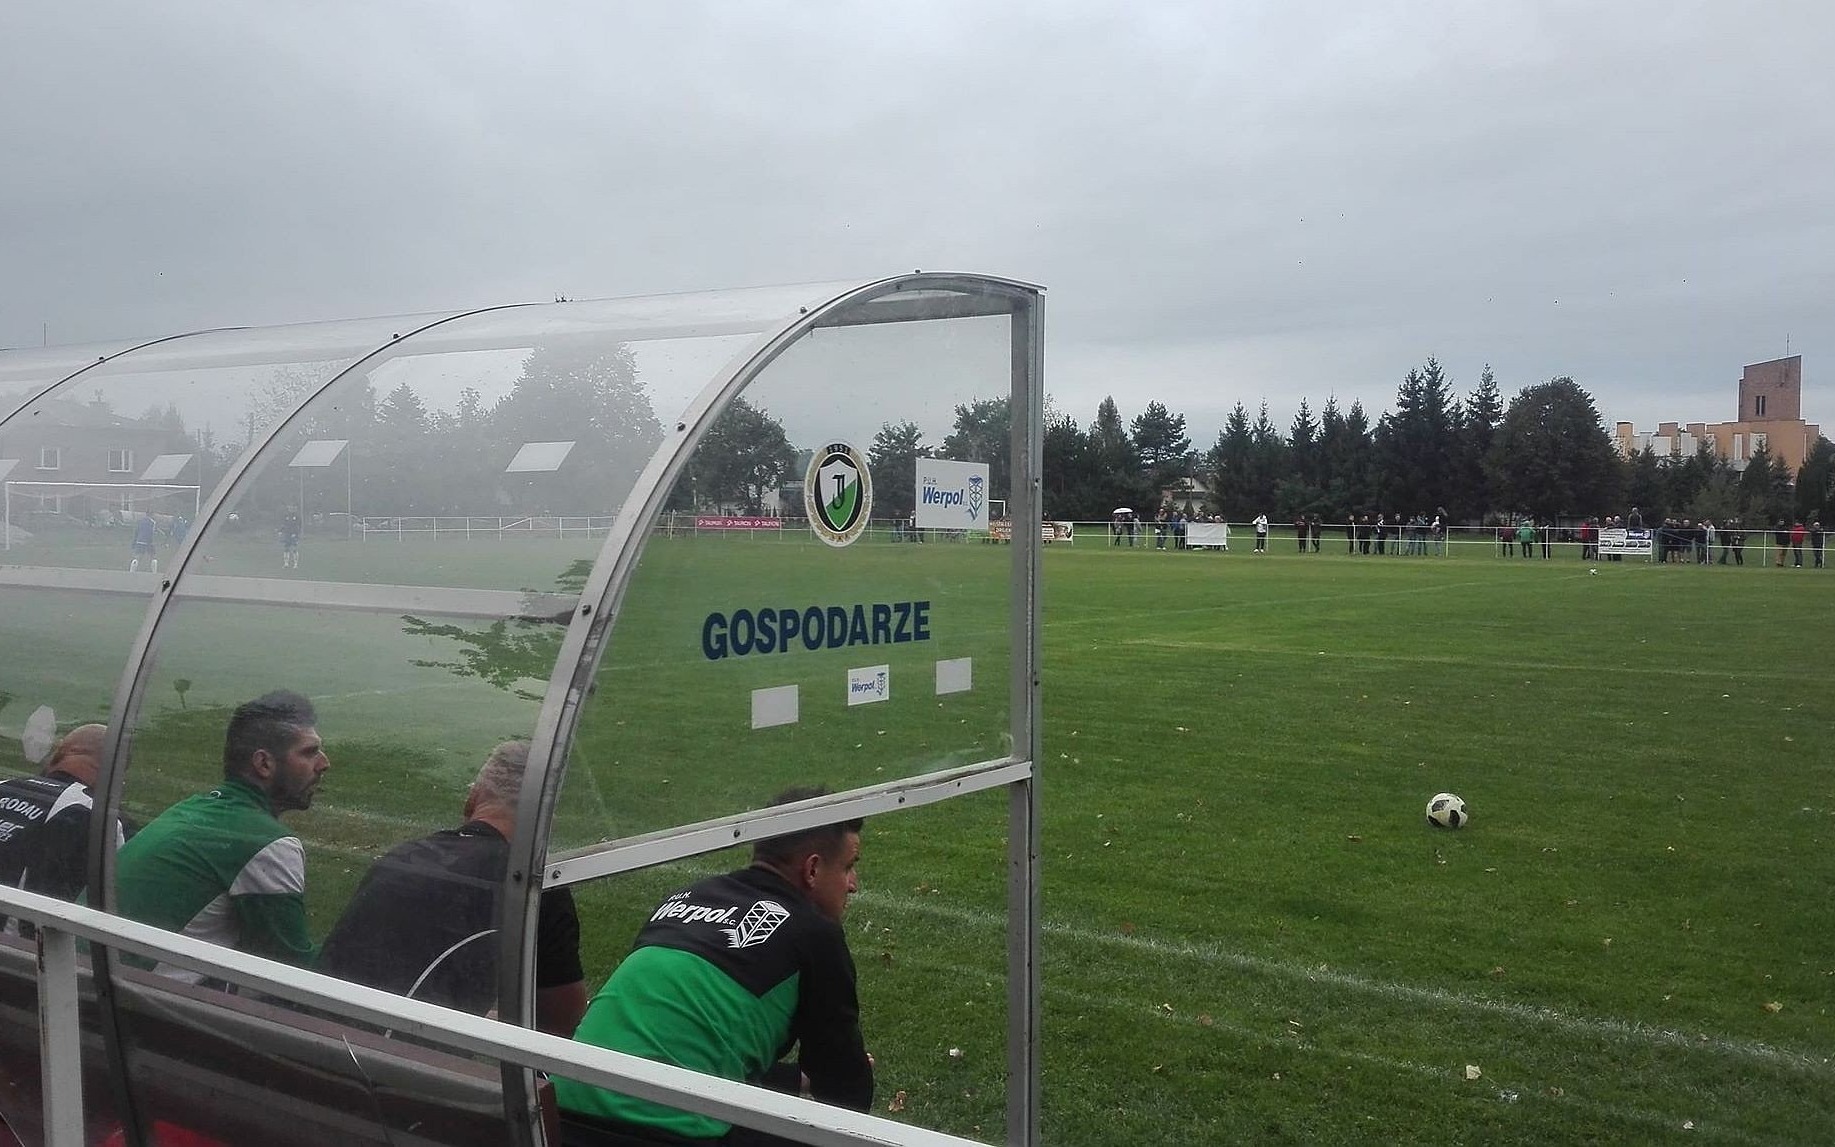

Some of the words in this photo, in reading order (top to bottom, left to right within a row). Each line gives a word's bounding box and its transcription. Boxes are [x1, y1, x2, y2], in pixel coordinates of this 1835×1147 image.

[923, 486, 964, 508] Werpol
[702, 600, 930, 660] GOSPODARZE
[851, 680, 875, 692] Werpol
[650, 900, 739, 924] Werpol
